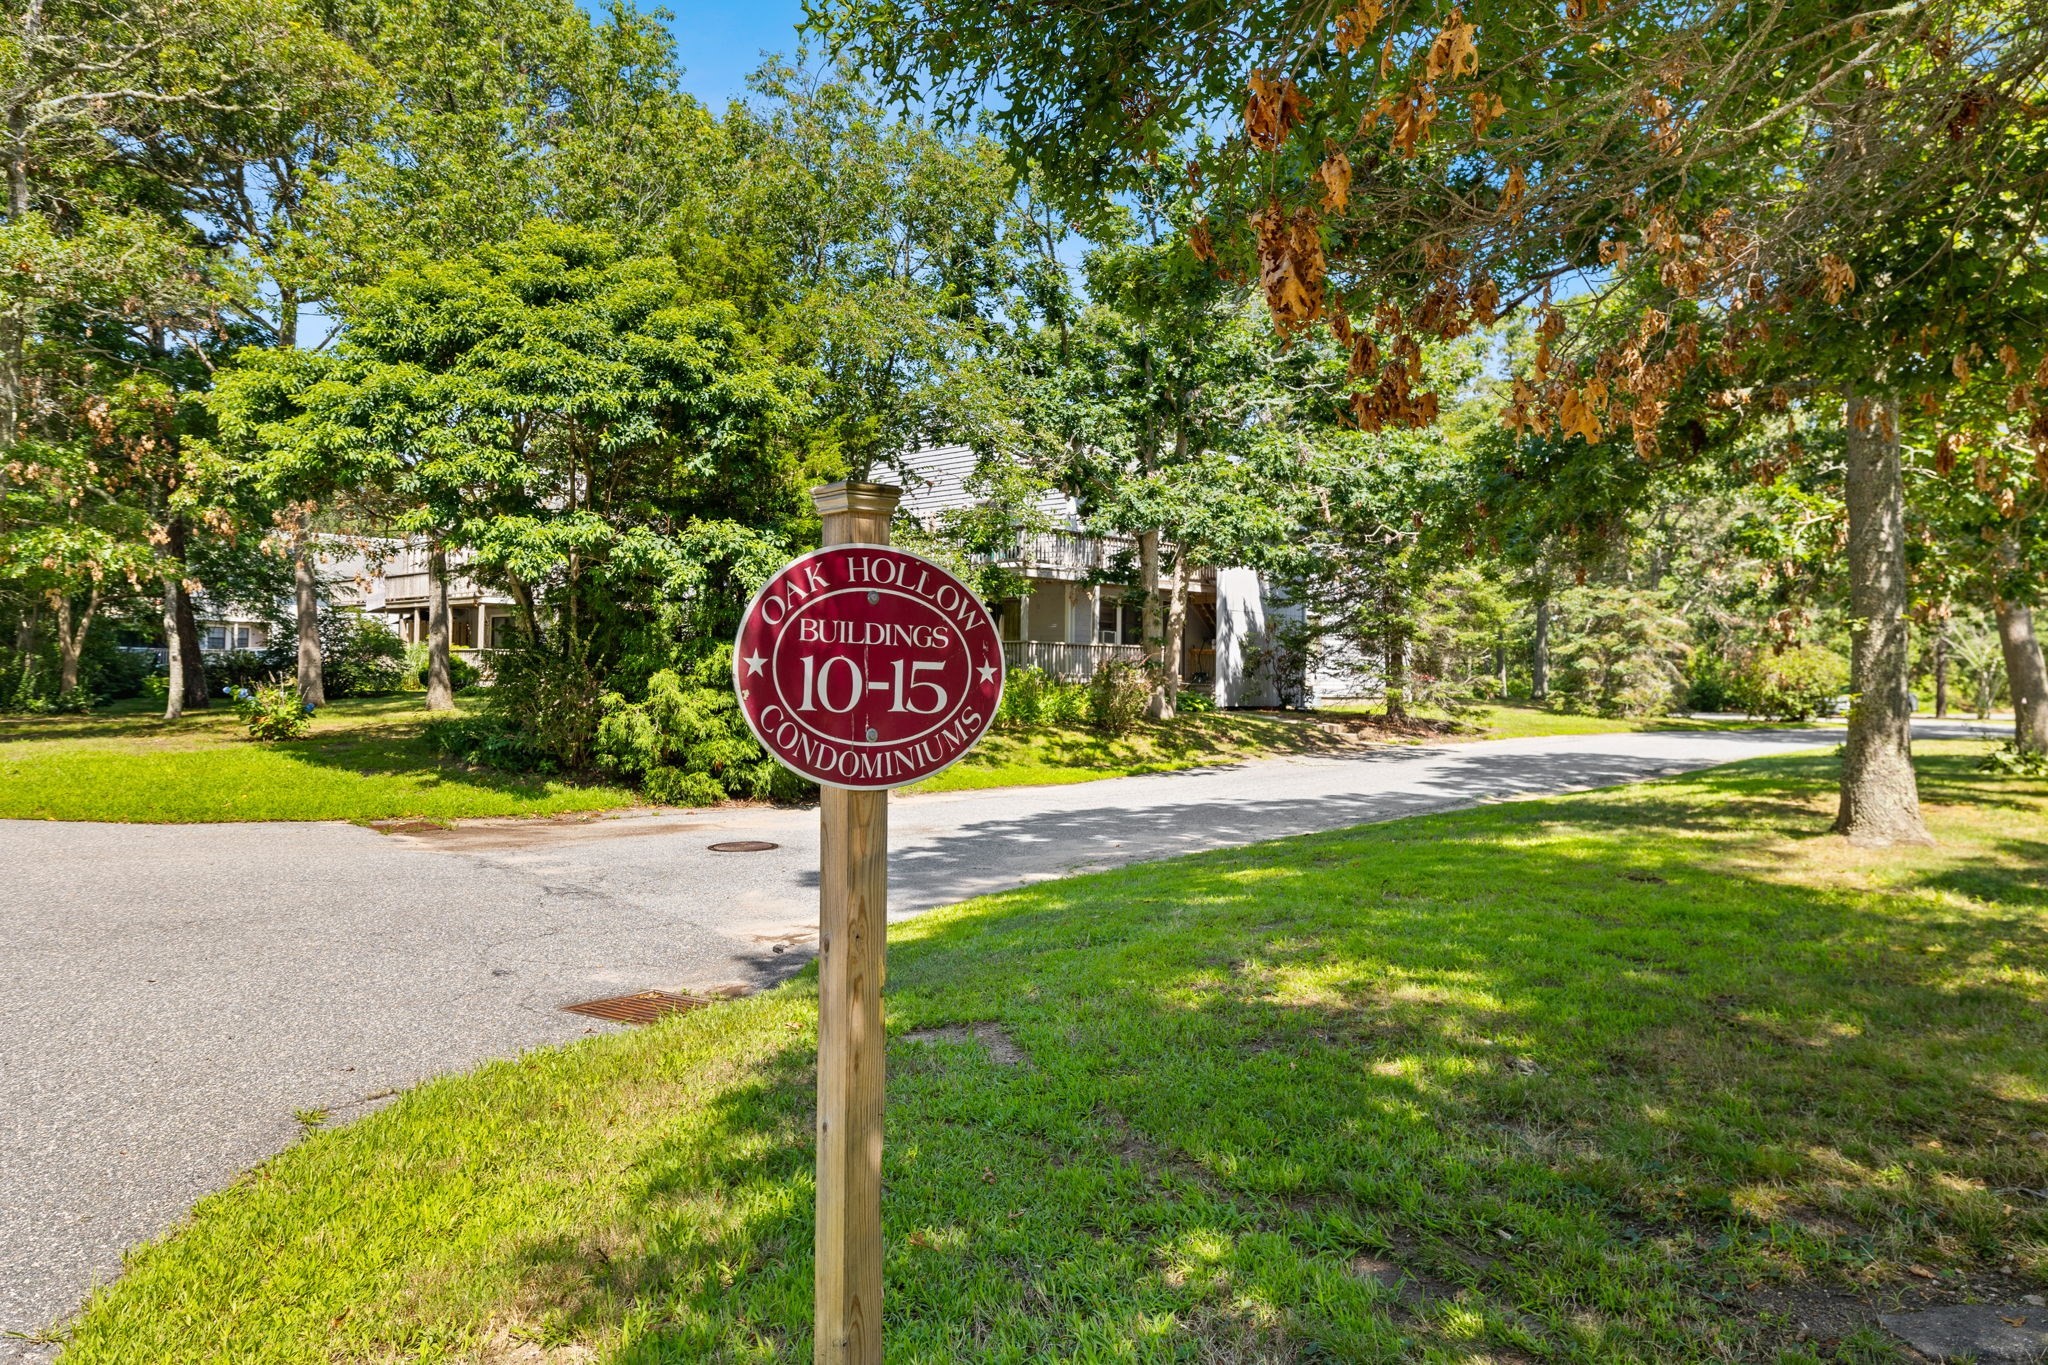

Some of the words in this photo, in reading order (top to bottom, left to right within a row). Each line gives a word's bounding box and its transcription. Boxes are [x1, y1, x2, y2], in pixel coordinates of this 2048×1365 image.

[761, 561, 831, 625] OAK
[848, 556, 986, 632] HOLLOW
[799, 618, 949, 648] BUILDINGS
[796, 655, 948, 715] 10-15
[760, 704, 982, 779] CONDOMINIUMS
